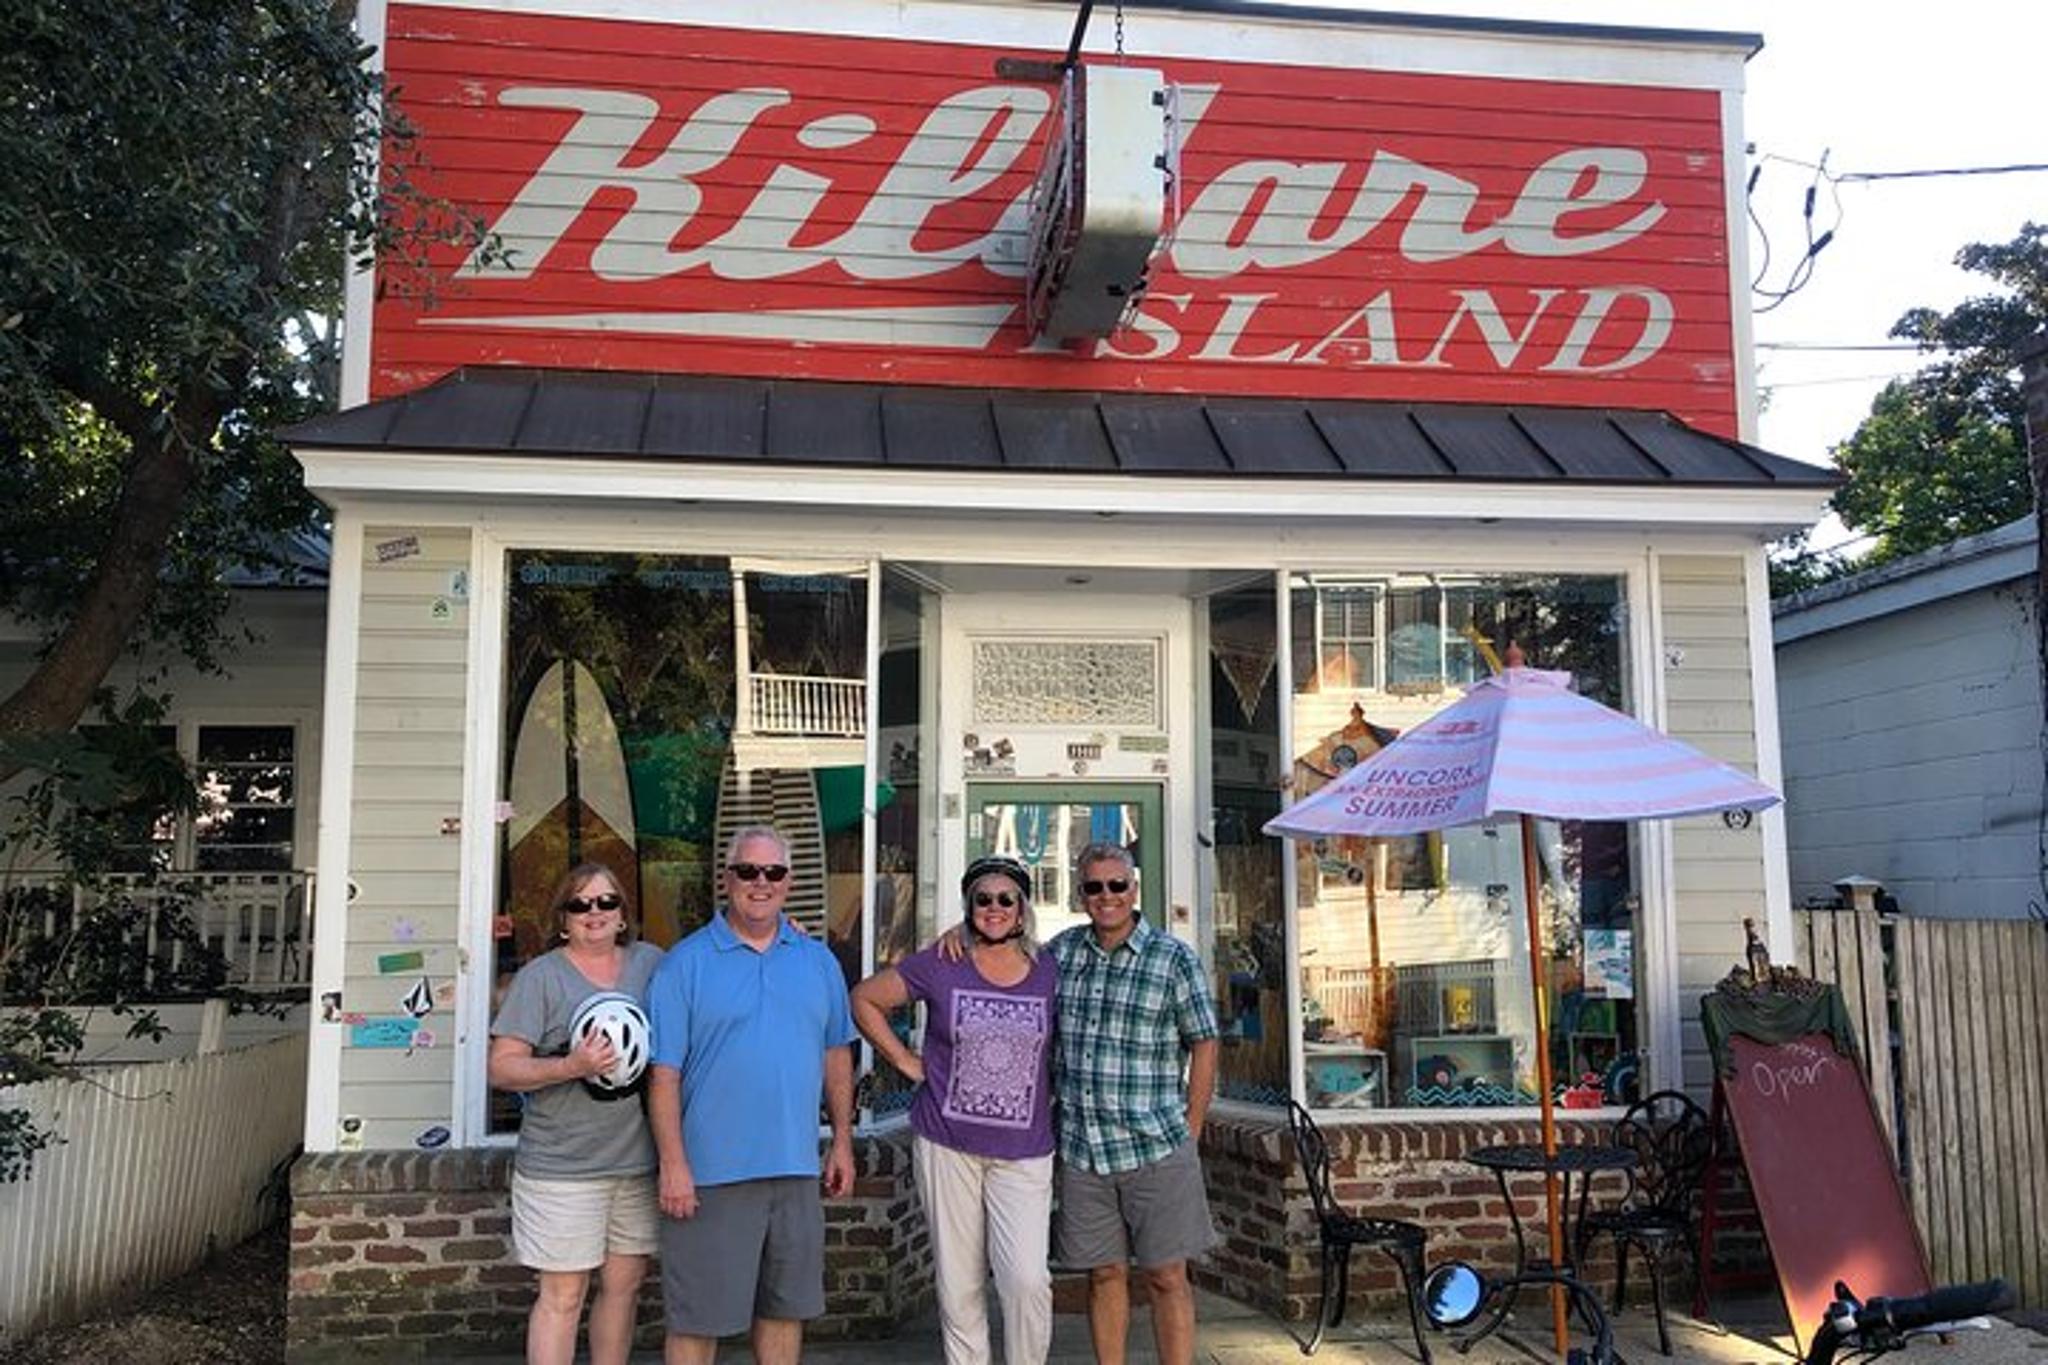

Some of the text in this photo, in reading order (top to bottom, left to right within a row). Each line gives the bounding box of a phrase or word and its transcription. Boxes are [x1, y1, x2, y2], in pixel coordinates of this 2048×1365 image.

[1017, 285, 1677, 374] SLAND
[1368, 763, 1480, 786] UNCORK
[1345, 795, 1459, 820] SUMMER
[1752, 1057, 1828, 1104] Open
